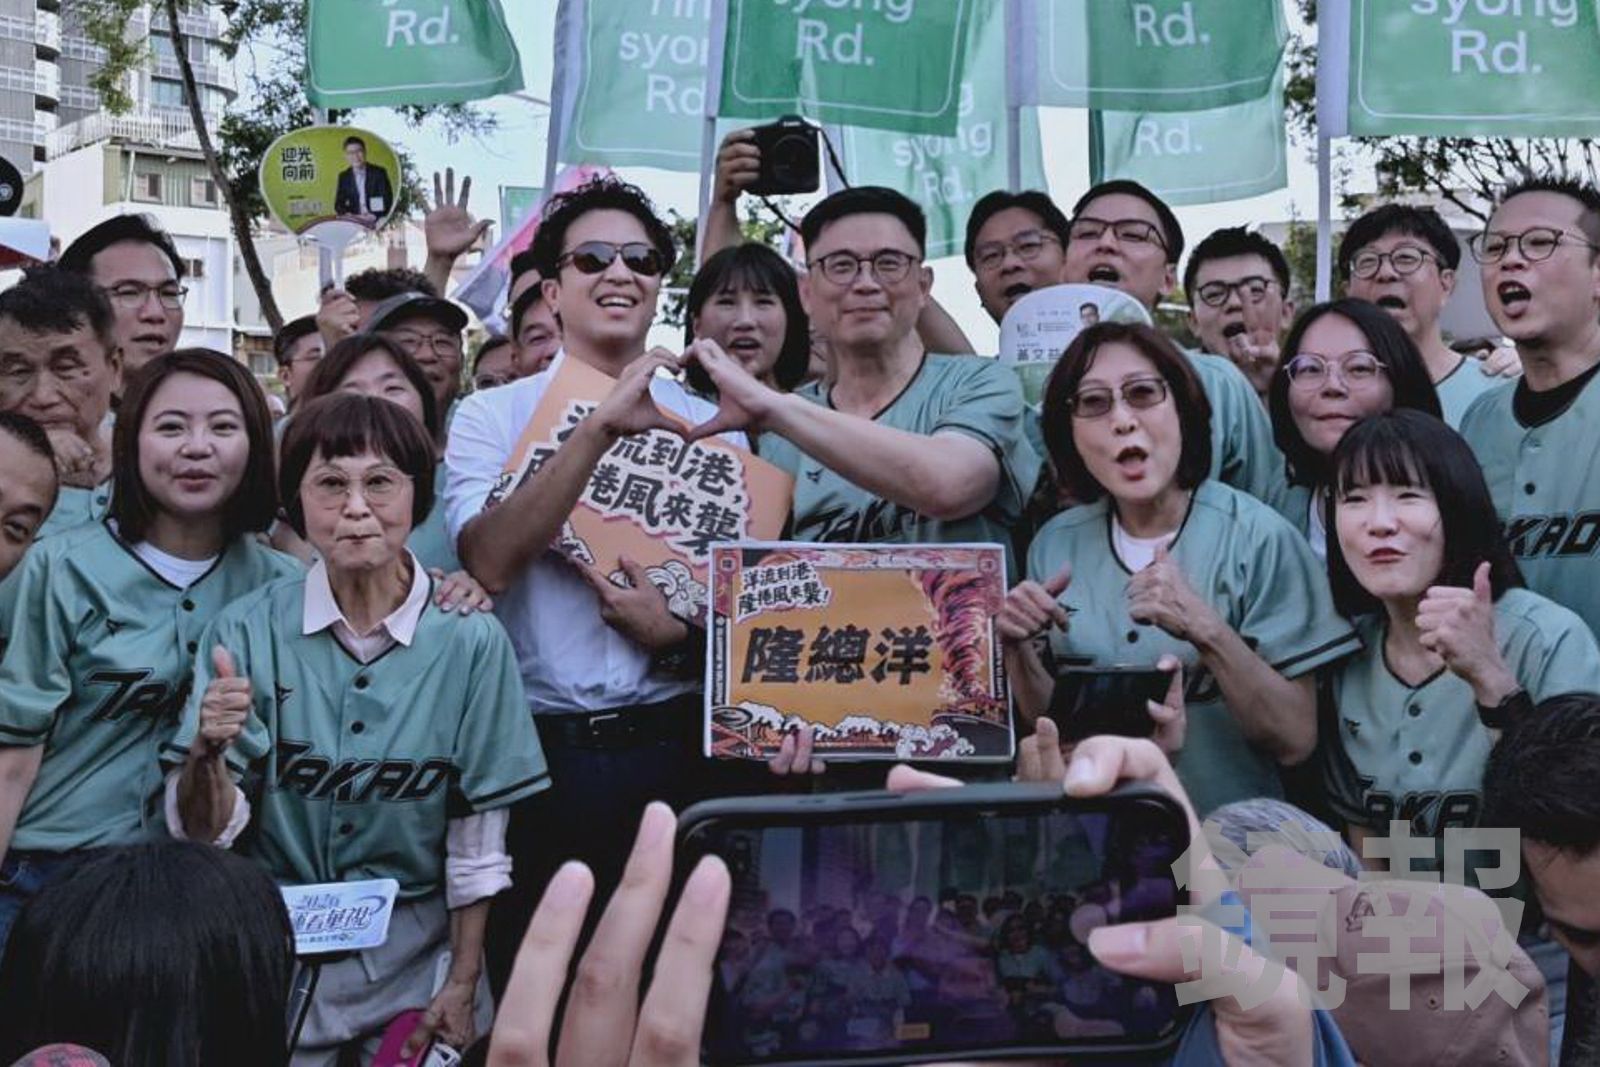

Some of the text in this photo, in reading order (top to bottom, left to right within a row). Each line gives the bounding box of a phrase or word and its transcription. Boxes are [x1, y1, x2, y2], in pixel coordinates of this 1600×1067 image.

[386, 5, 459, 47] Rd.
[795, 17, 876, 66] Rd.
[1134, 1, 1211, 47] Rd.
[619, 31, 710, 69] syo
[1451, 29, 1543, 74] Rd.
[1133, 117, 1203, 156] Rd.
[922, 164, 974, 205] Rd.
[741, 624, 934, 686] 隆總洋
